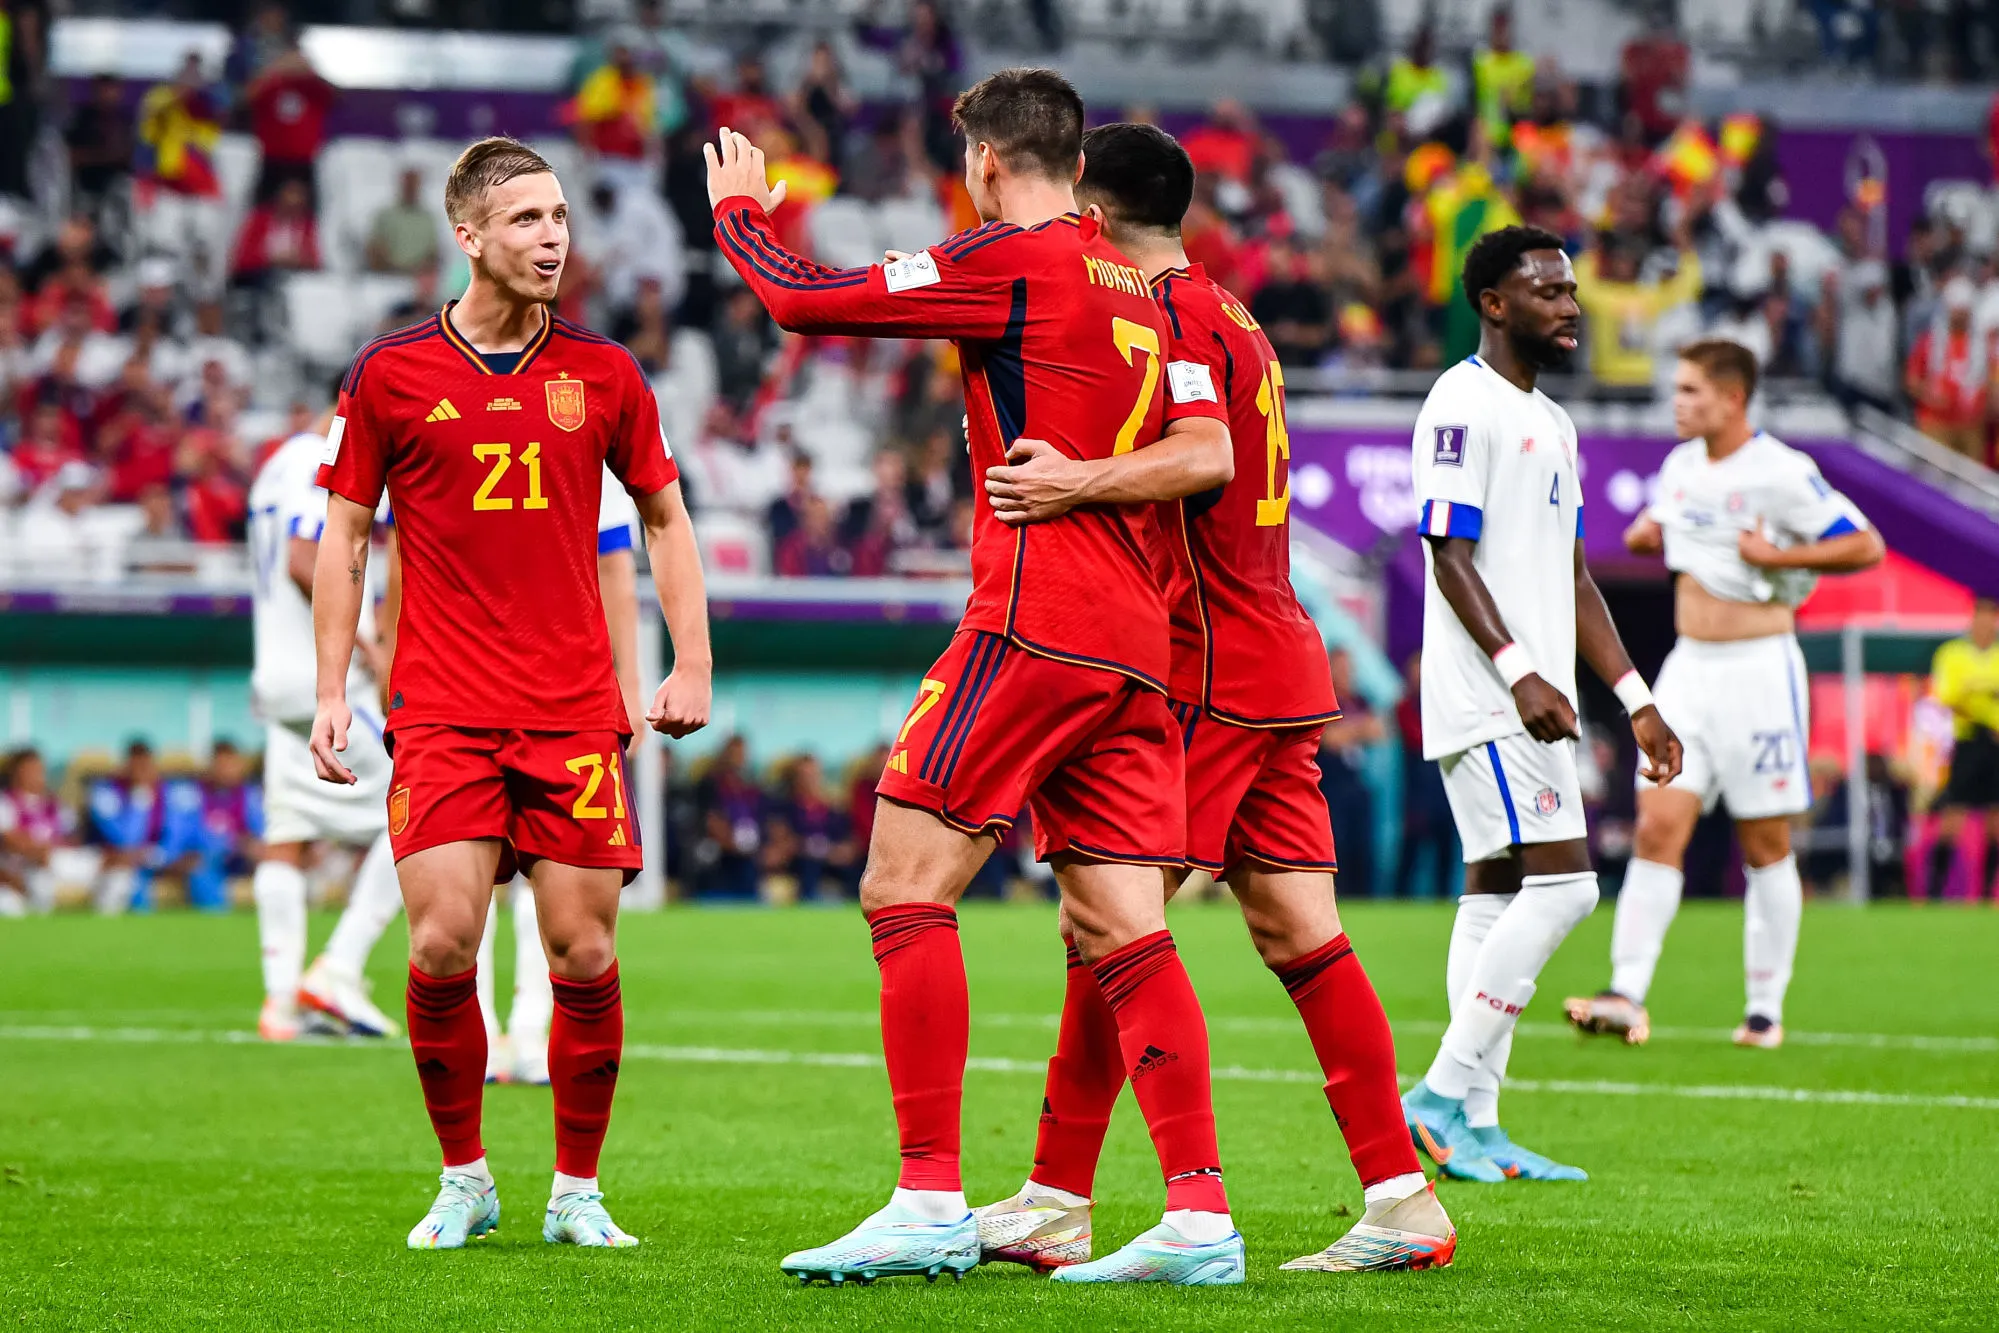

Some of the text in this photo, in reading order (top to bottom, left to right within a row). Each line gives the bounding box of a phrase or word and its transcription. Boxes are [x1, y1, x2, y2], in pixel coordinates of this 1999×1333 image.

[1112, 316, 1161, 457] 7
[472, 442, 549, 511] 21
[1549, 471, 1560, 505] 4
[899, 678, 946, 743] 7
[565, 752, 625, 819] 21
[1131, 1052, 1179, 1083] adidas
